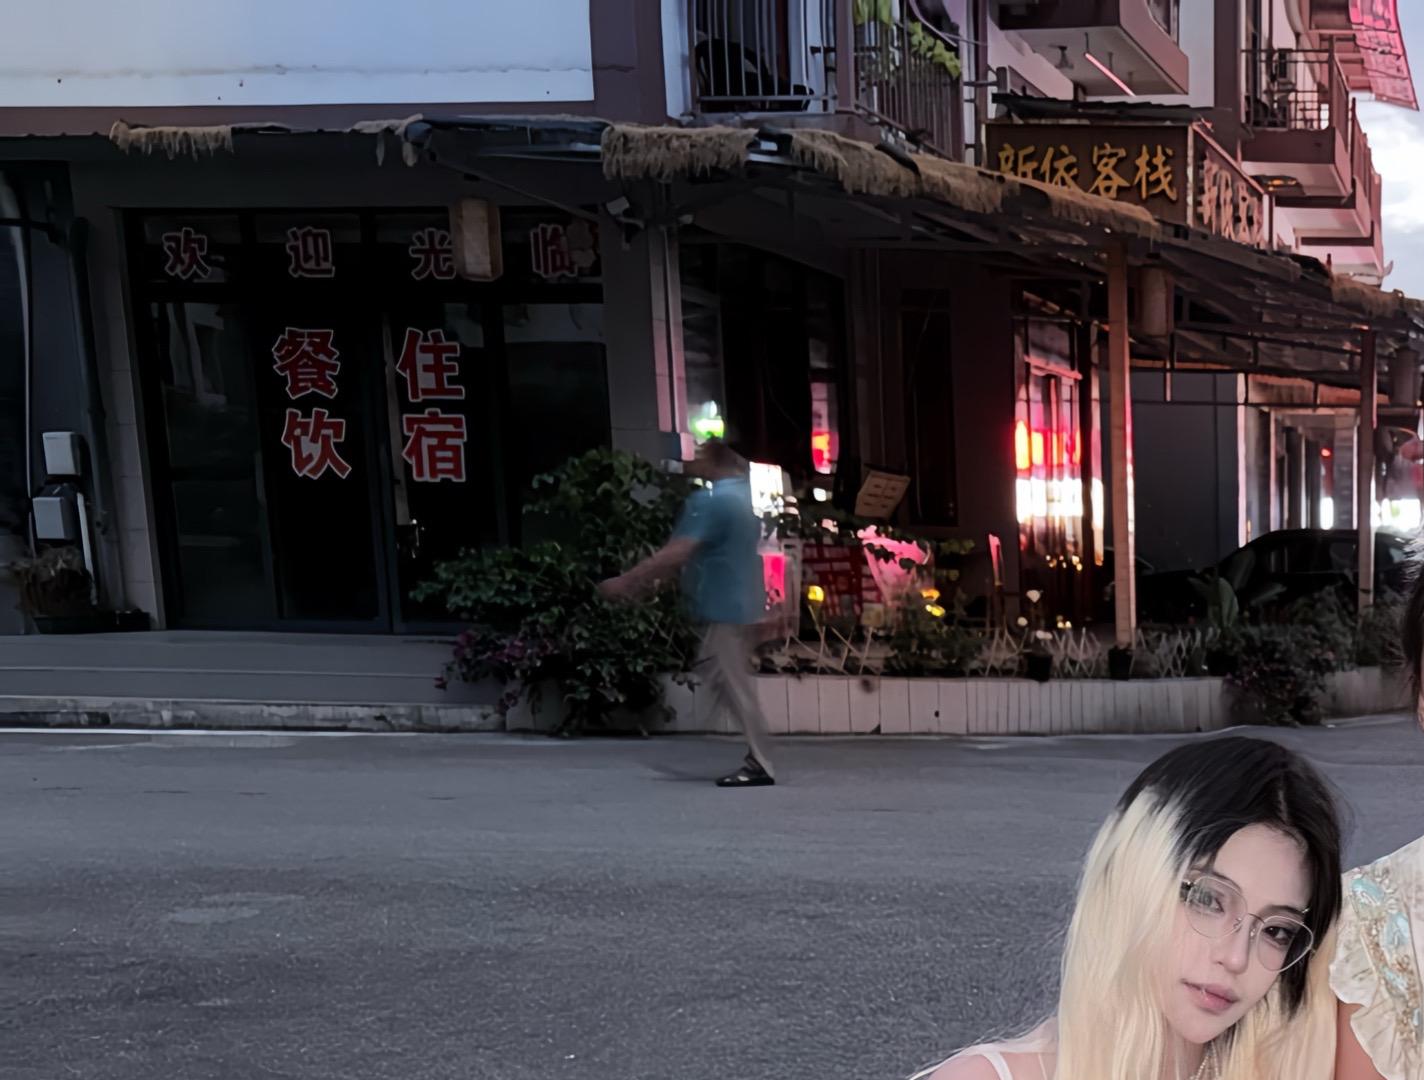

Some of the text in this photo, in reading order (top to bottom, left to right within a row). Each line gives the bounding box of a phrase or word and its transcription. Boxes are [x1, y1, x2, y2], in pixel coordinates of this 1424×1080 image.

[163, 225, 578, 280] 欢迎光临
[273, 327, 352, 480] 餐饮
[397, 328, 467, 482] 住宿
